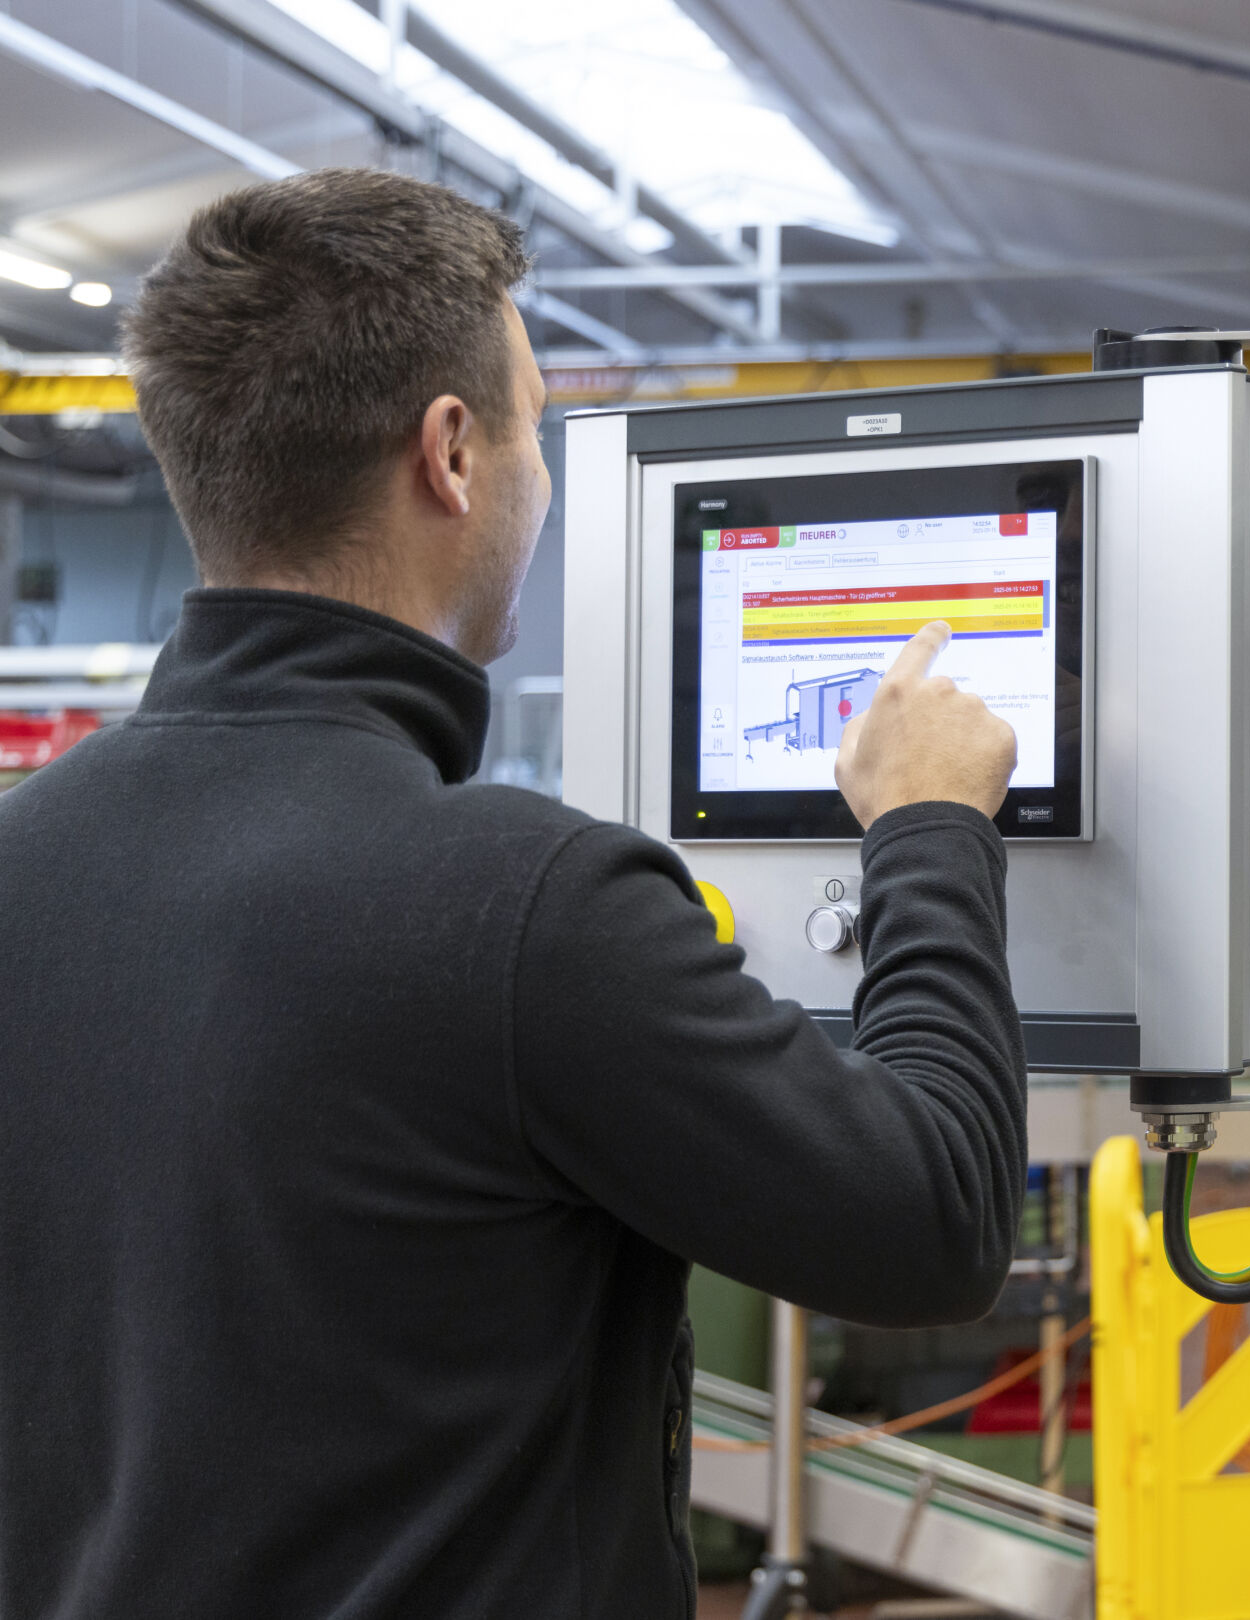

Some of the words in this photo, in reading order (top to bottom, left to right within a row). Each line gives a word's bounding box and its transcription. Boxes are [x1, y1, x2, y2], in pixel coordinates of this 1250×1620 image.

[701, 500, 726, 509] Harmony
[800, 530, 837, 541] MEURER
[788, 653, 815, 661] Software
[1020, 808, 1051, 817] Schneider
